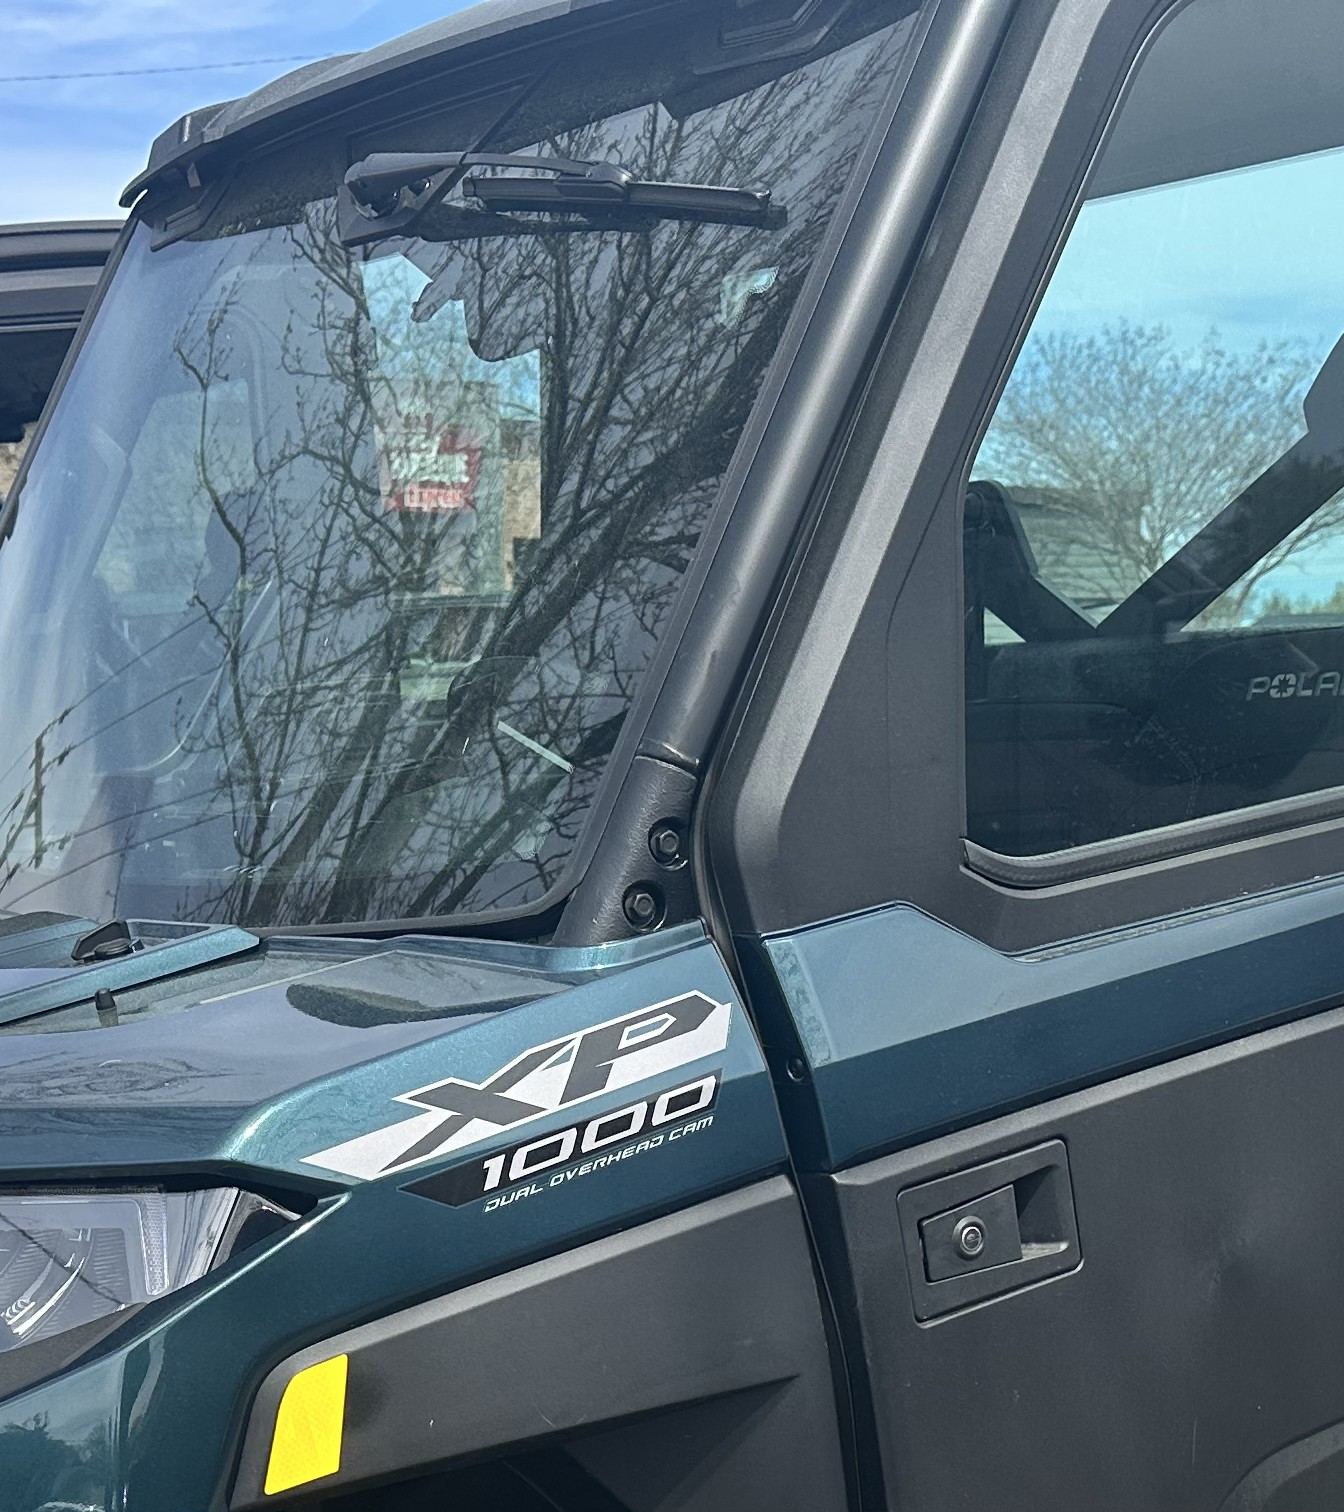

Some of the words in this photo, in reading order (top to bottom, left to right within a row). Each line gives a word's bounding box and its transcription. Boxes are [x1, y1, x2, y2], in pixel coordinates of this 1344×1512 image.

[374, 991, 721, 1177] XP
[481, 1074, 718, 1193] 1000
[483, 1181, 544, 1213] DUAL
[549, 1135, 665, 1188] OVERHEAD
[667, 1115, 714, 1145] CAM
